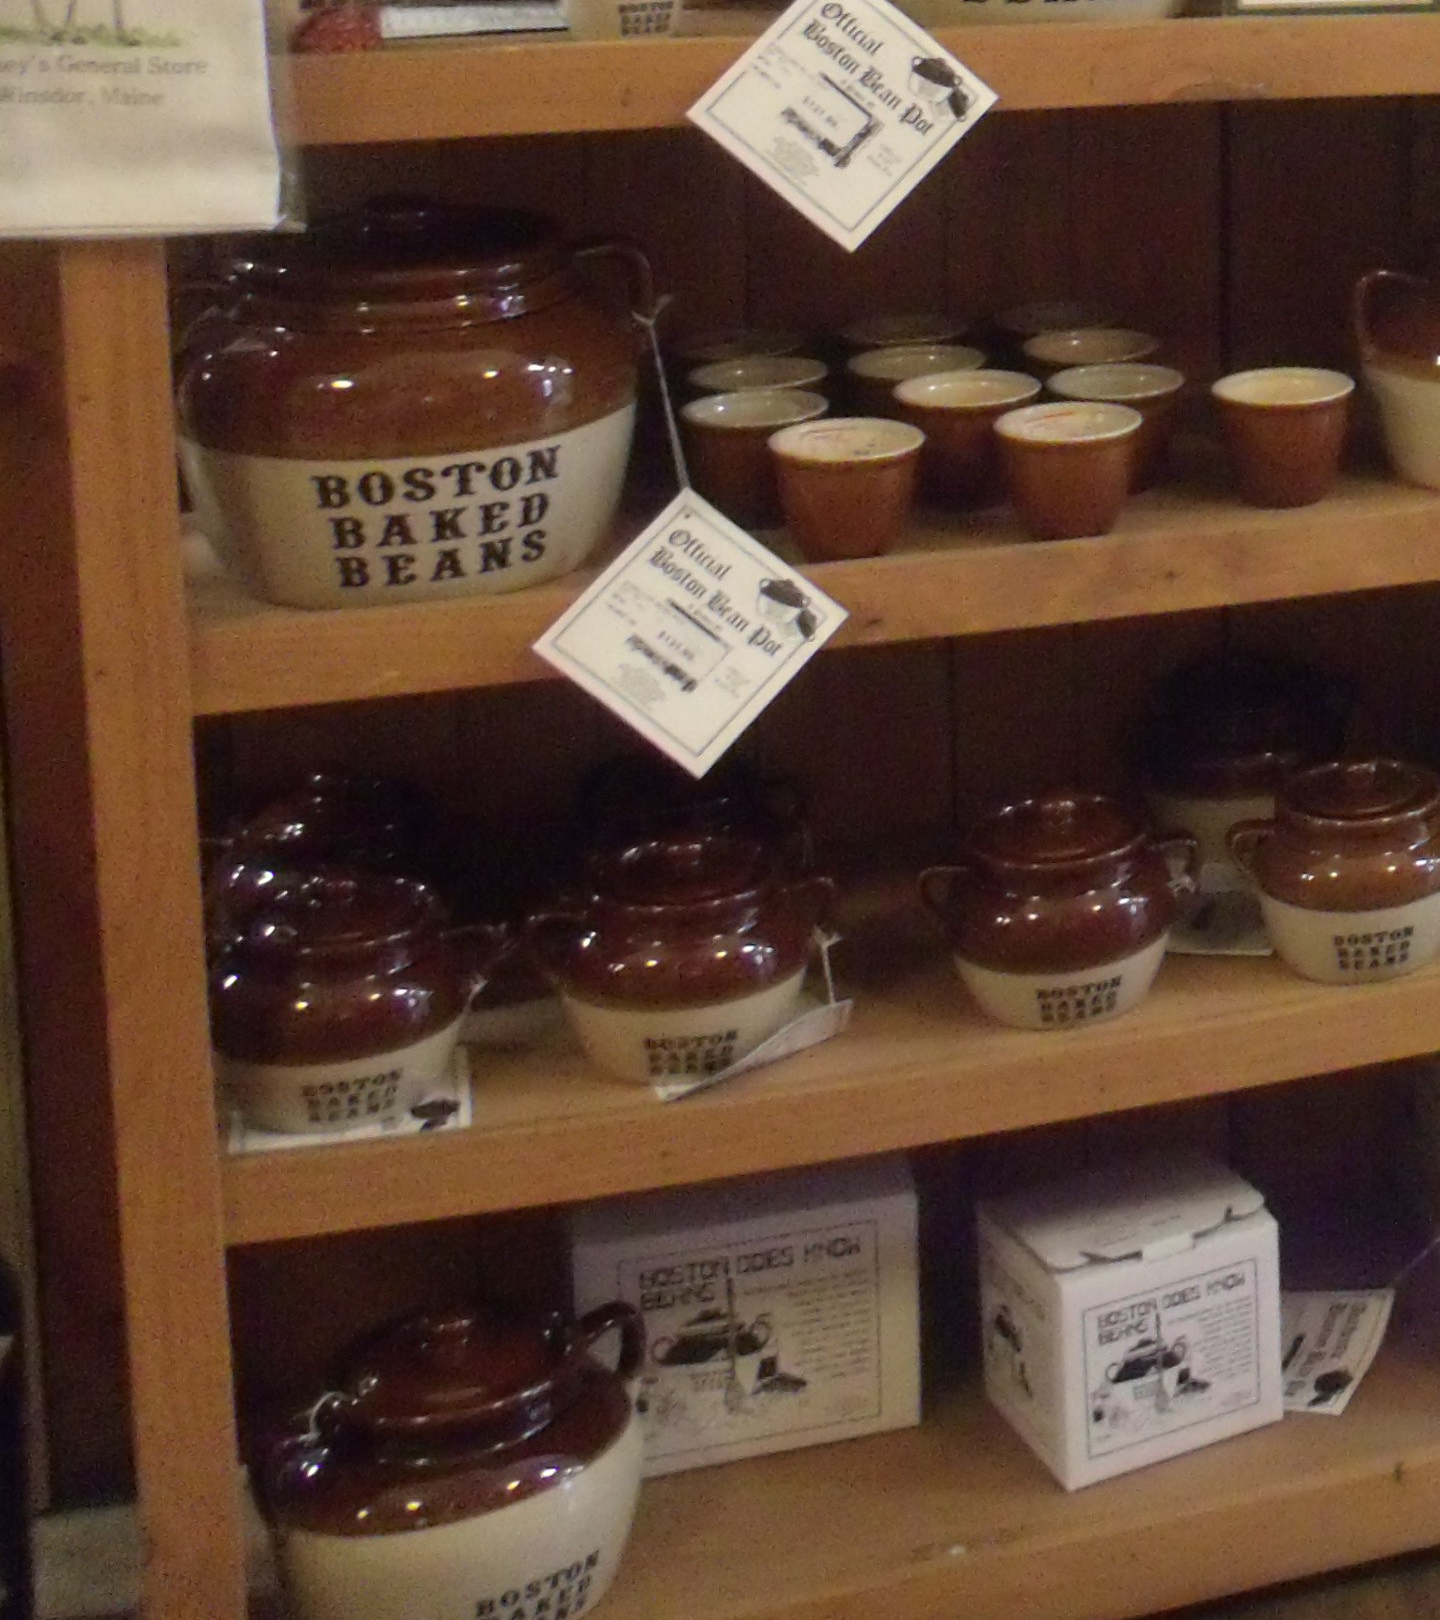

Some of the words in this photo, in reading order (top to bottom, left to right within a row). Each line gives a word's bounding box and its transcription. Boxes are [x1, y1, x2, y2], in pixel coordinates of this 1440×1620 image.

[821, 2, 885, 57] Official
[156, 53, 208, 77] Store
[803, 18, 860, 75] Boston
[861, 66, 901, 110] Bean
[899, 102, 935, 136] Pot
[312, 444, 564, 511] BOSTON
[330, 492, 551, 550] BAKED
[337, 531, 548, 589] BEANS
[668, 530, 733, 580] Official
[650, 546, 708, 598] Boston
[707, 590, 750, 632] Bean
[747, 626, 785, 657] Pot
[1334, 925, 1414, 947] BOSTON
[1035, 975, 1122, 1000] BOSTON
[476, 1548, 601, 1618] BOSTON
[477, 1573, 593, 1620] AKED
